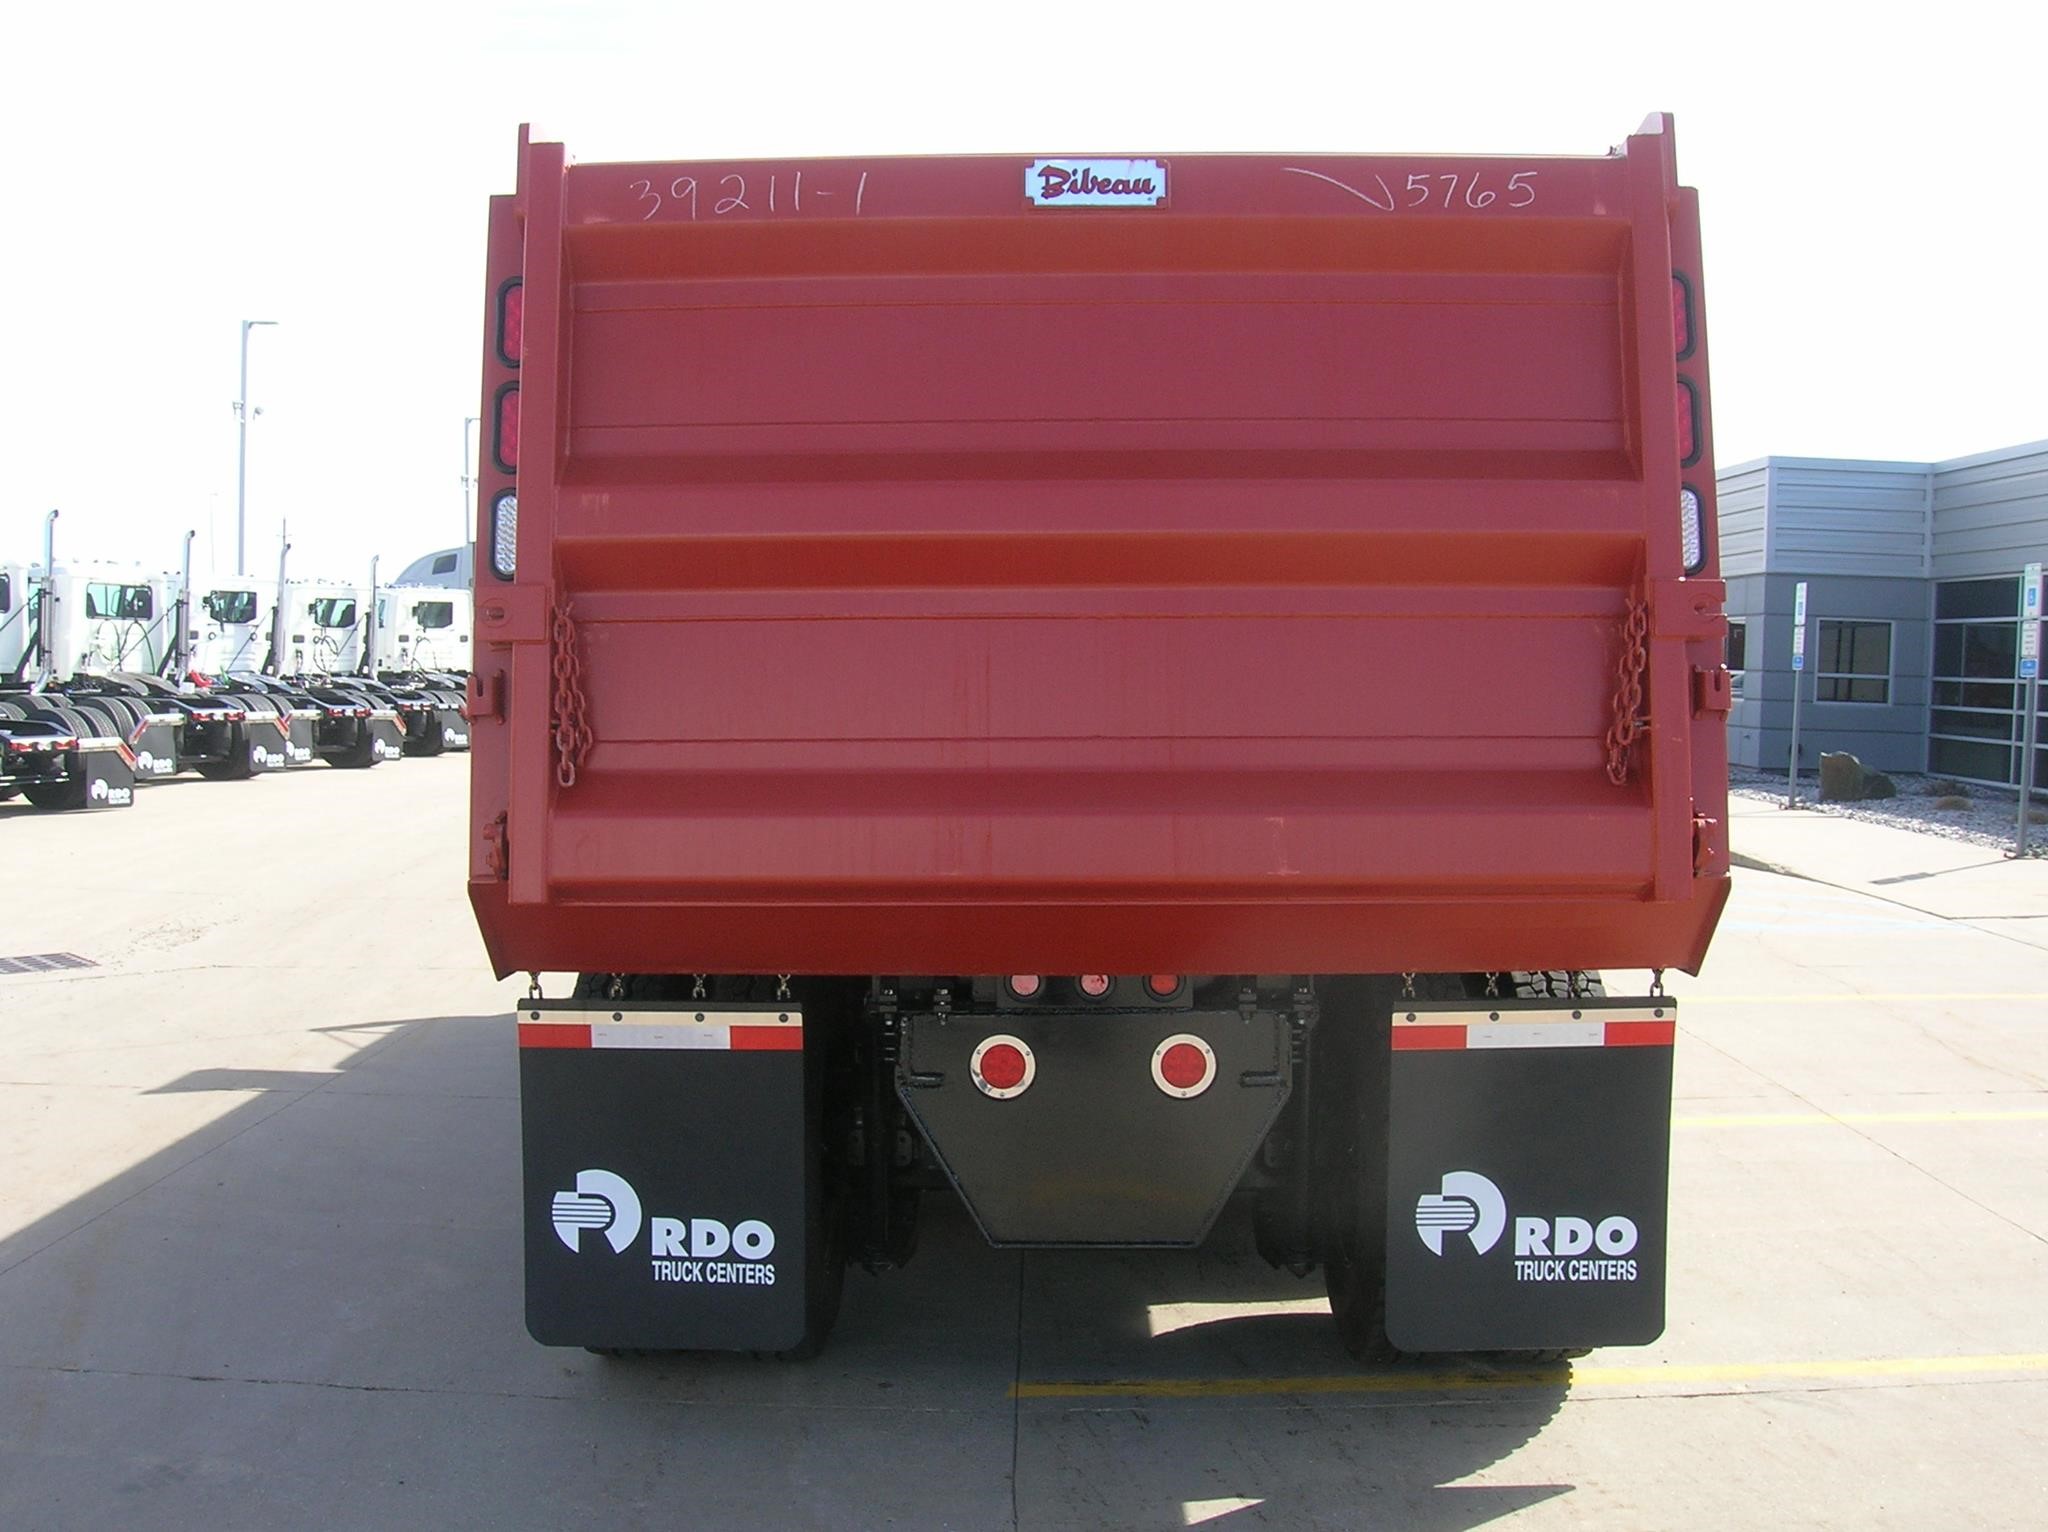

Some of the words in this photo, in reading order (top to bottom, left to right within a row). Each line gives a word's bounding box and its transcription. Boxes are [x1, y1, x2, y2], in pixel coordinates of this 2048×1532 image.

[630, 171, 867, 221] 39211-1
[1037, 165, 1156, 200] Bibeau
[651, 1217, 775, 1260] RDO
[1515, 1216, 1638, 1256] RDO
[652, 1261, 703, 1282] TRUCK
[706, 1263, 775, 1285] CENTERS
[1515, 1260, 1565, 1281] TRUCK
[1569, 1260, 1637, 1281] CENTERS
